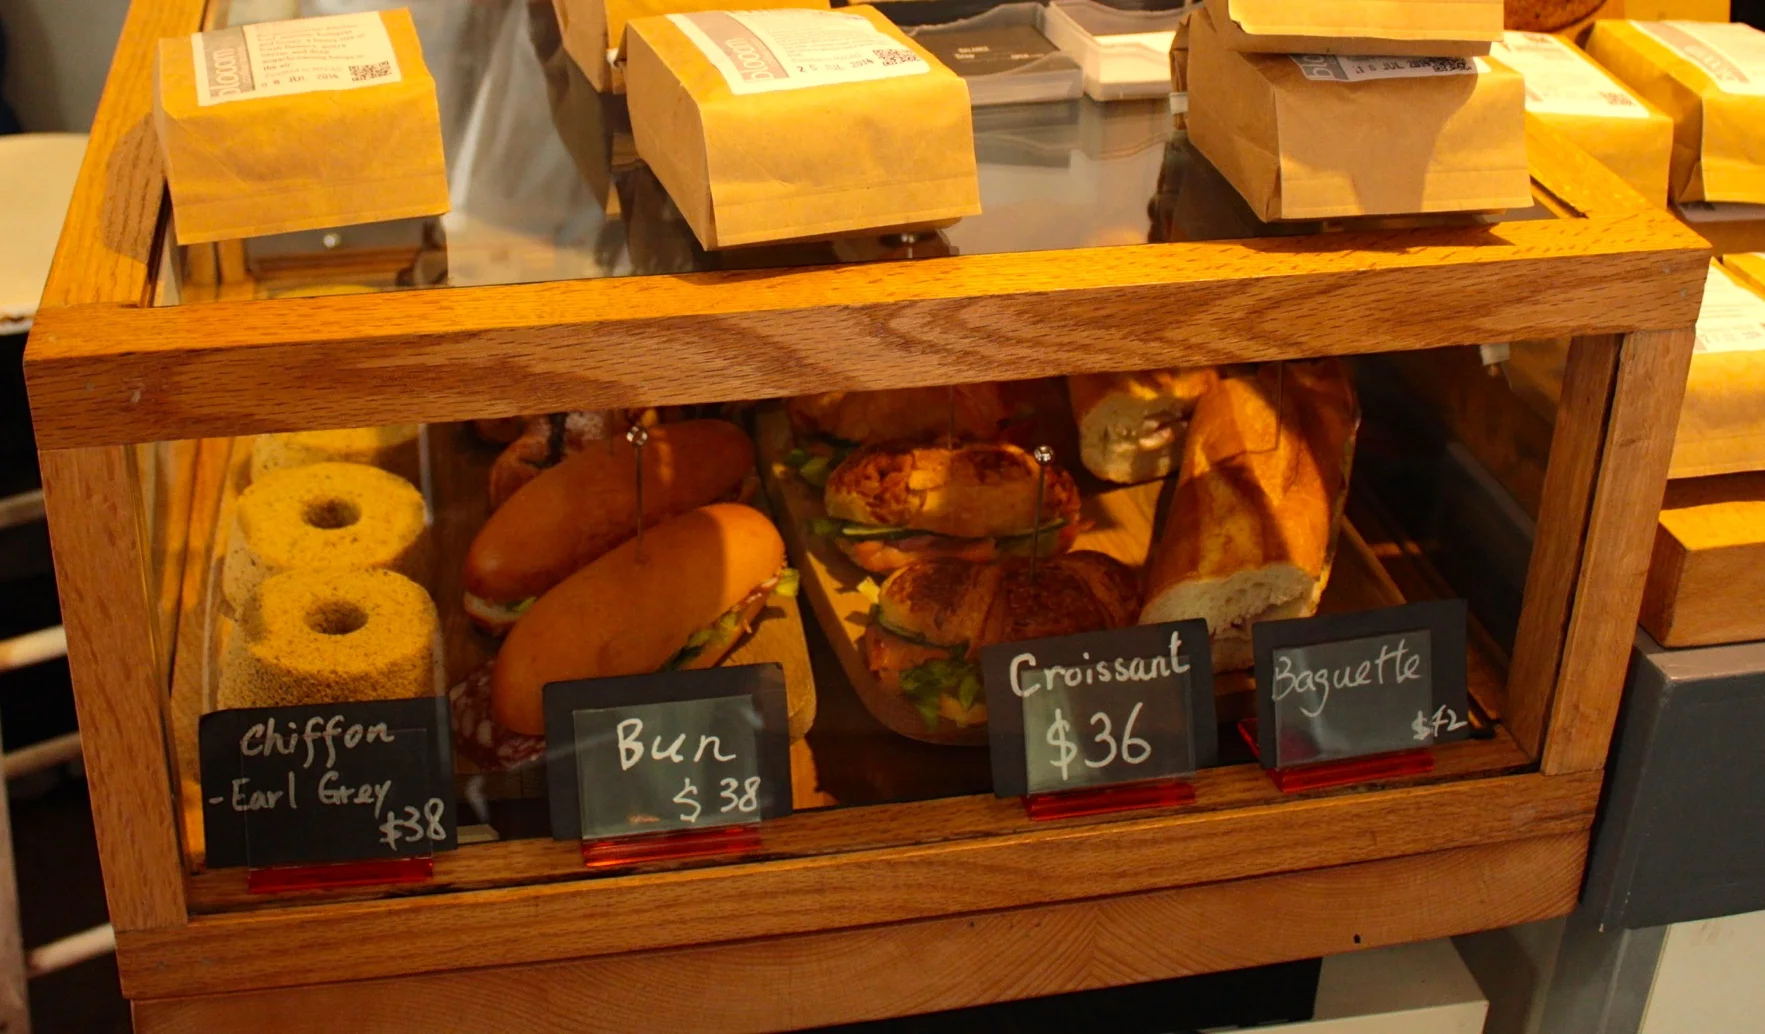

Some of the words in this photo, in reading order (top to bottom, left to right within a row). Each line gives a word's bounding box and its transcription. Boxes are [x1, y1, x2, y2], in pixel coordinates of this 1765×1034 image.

[1383, 61, 1404, 71] JUL
[1009, 631, 1191, 697] Croissant
[1271, 638, 1423, 718] Baguette
[240, 715, 395, 768] Chiffon
[617, 718, 738, 771] Bun
[1046, 702, 1152, 781] $36
[318, 770, 392, 819] Grey
[379, 798, 447, 851] $38
